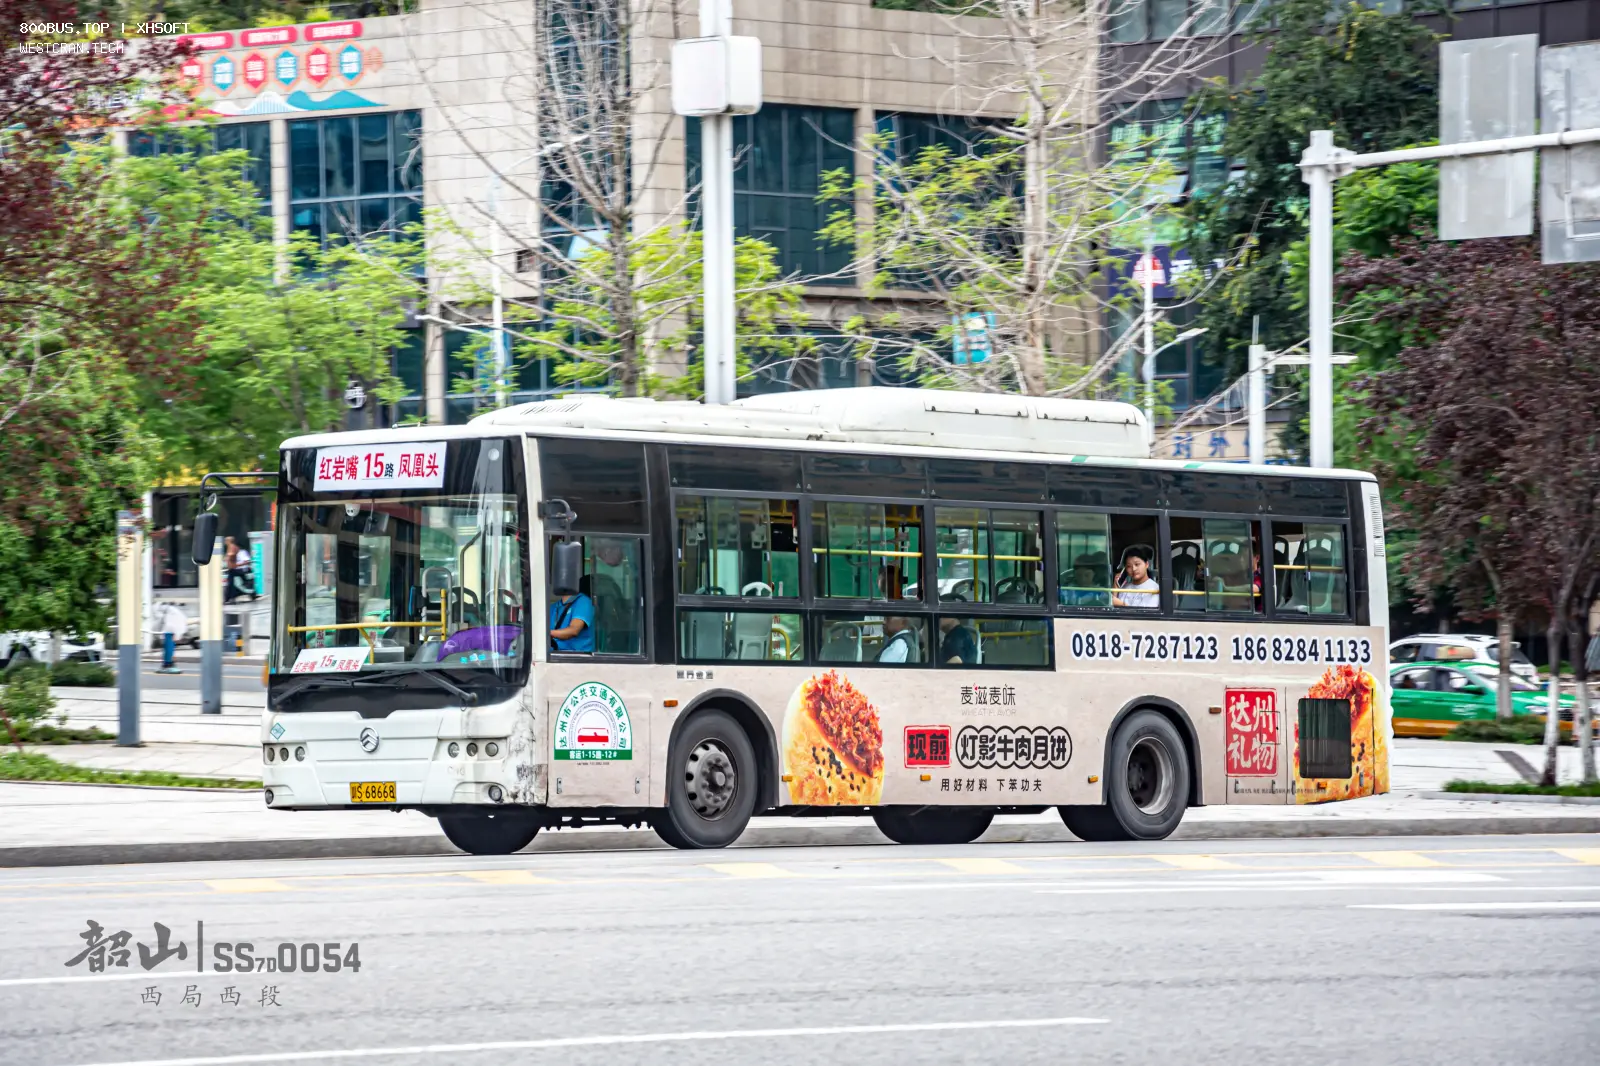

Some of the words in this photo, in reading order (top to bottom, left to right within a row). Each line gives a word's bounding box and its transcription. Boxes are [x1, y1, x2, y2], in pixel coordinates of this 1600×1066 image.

[318, 454, 359, 481] 红岩嘴
[363, 453, 394, 479] 15路
[398, 452, 439, 478] 凤凰头
[1071, 632, 1218, 661] 0818-7287123
[559, 686, 627, 749] 达州市公共交通有限公司
[1228, 693, 1274, 734] 达州
[908, 733, 947, 761] 现煎
[960, 734, 1067, 762] 灯影牛肉月饼
[1227, 733, 1276, 771] 礼物
[940, 778, 988, 792] 用好材料
[996, 778, 1043, 792] 下笨功夫
